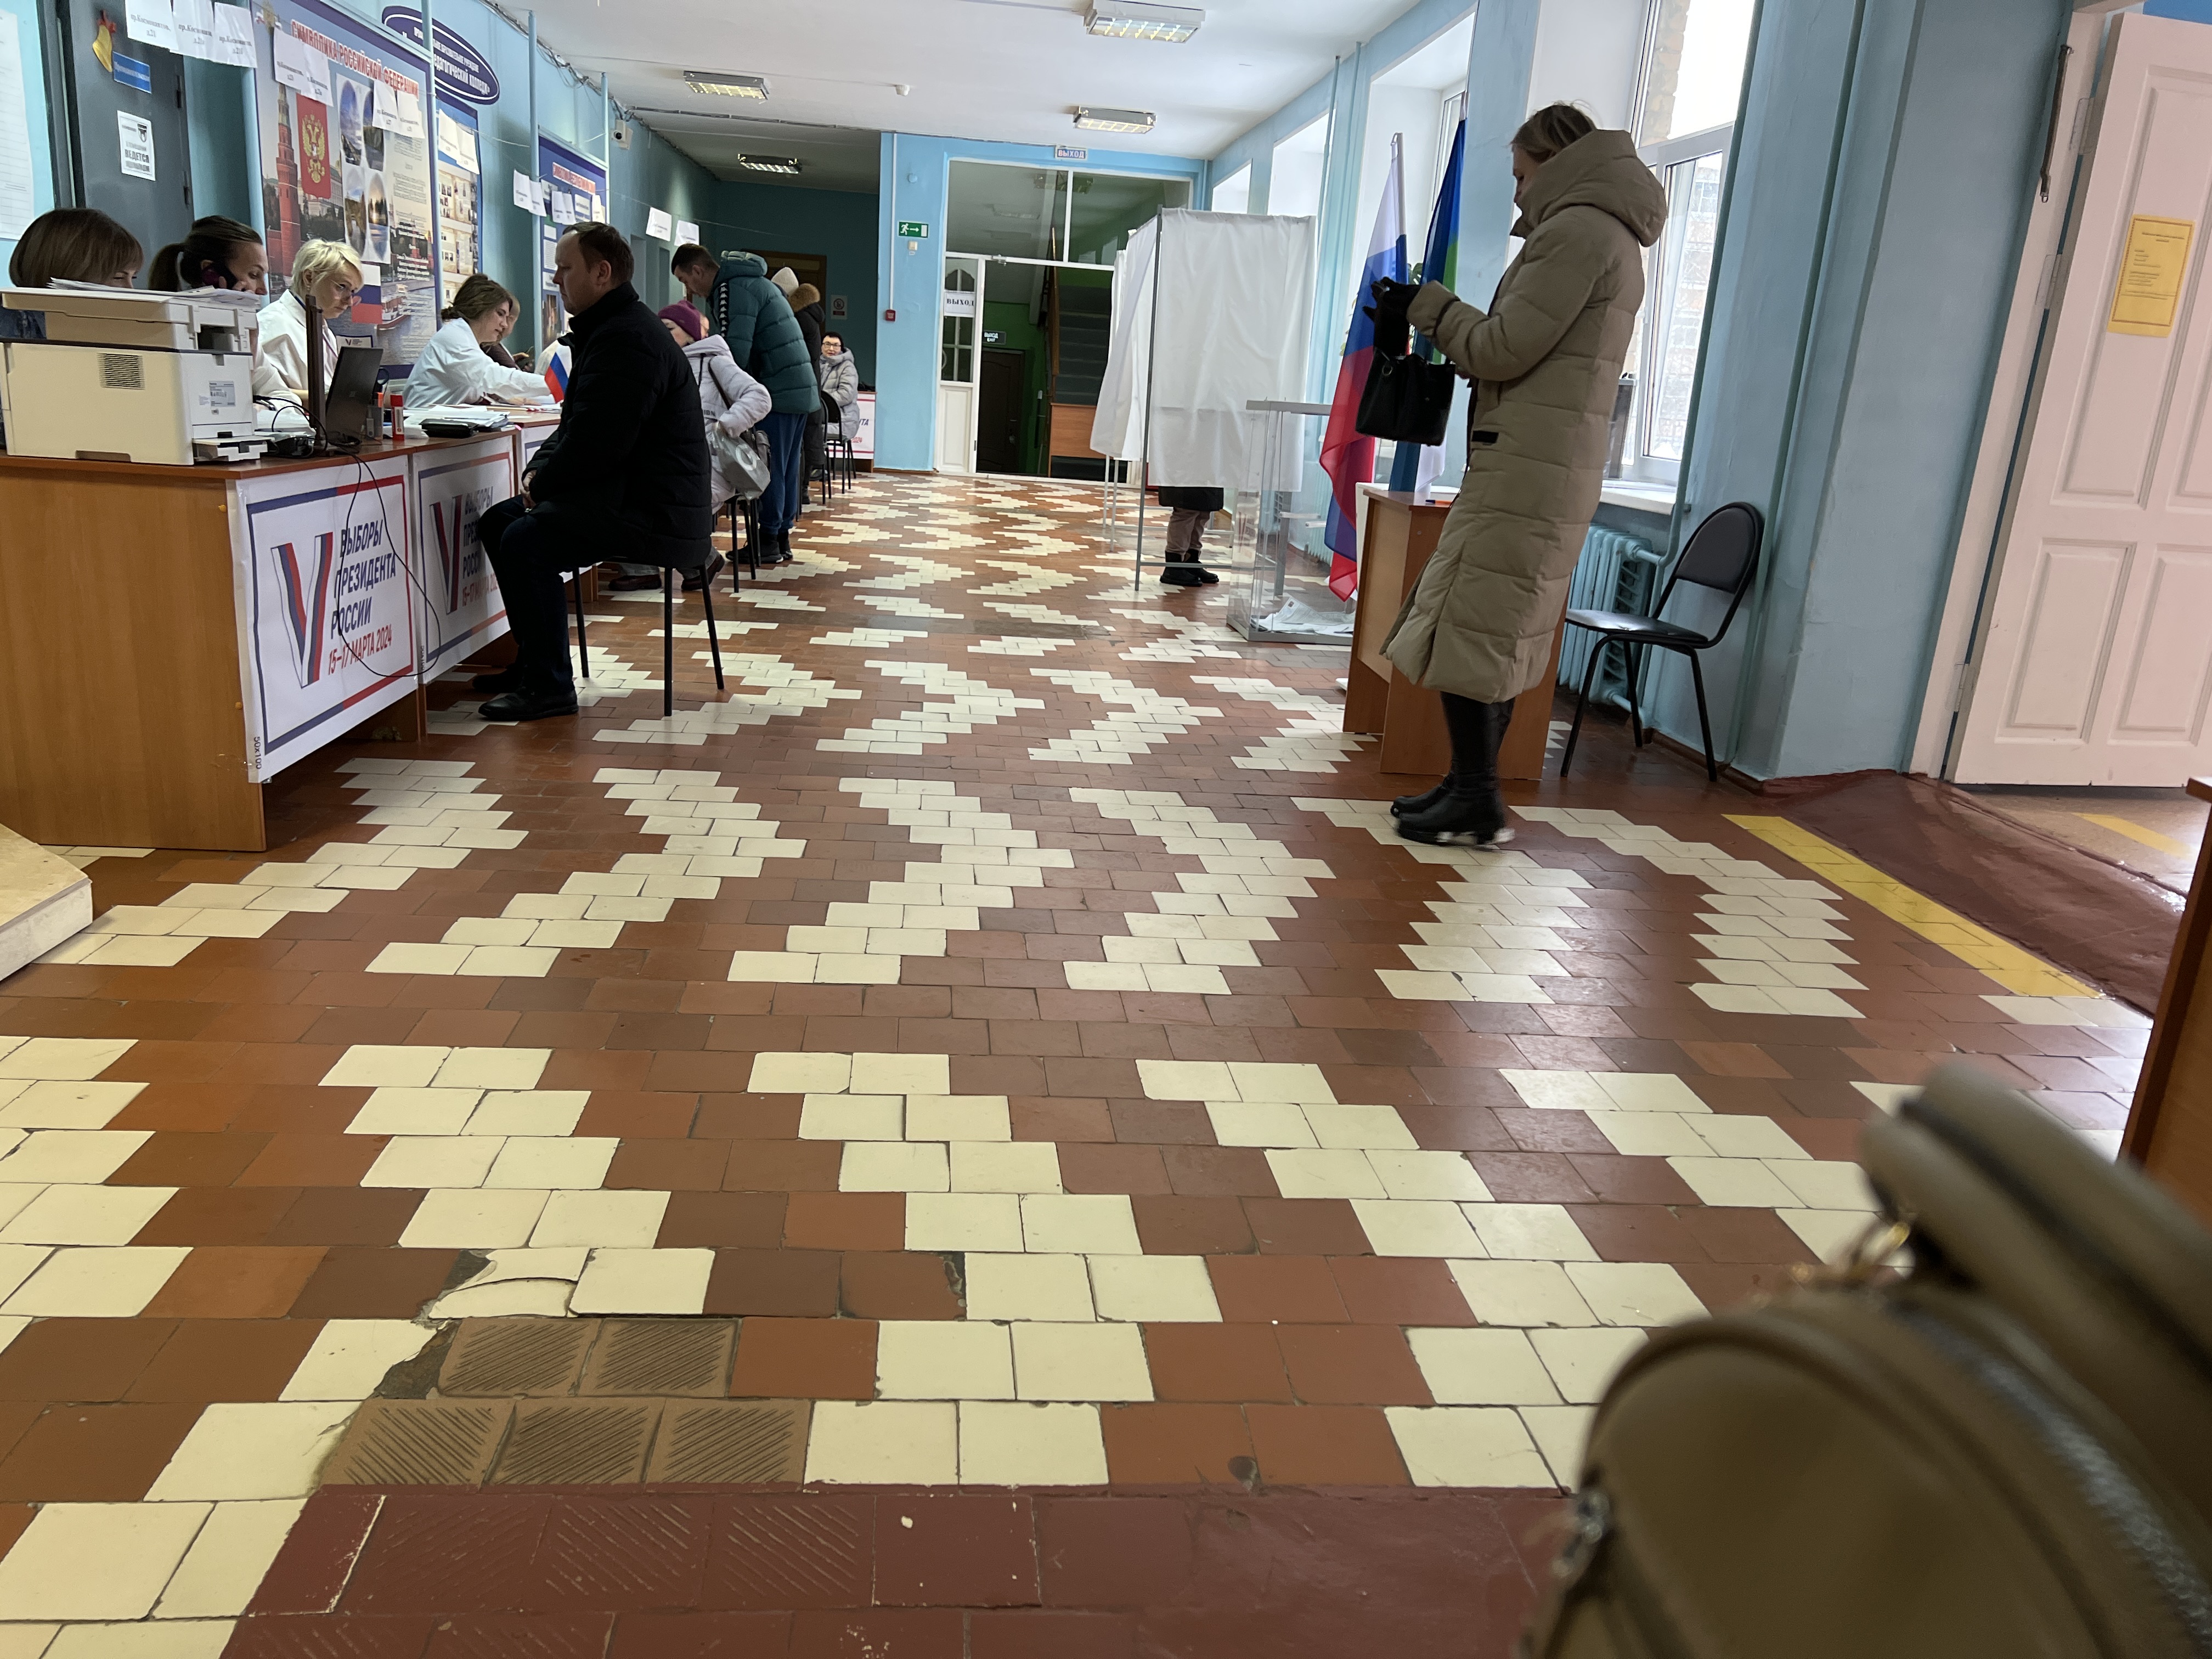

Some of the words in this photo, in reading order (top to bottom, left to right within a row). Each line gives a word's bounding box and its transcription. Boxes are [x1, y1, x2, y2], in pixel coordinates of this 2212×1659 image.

[338, 48, 382, 81] РОССИЙСКОЙ
[1058, 150, 1085, 159] ВЫХОД
[947, 298, 974, 307] ВЫХОД
[340, 519, 383, 557] ВЫБОРЫ
[334, 552, 396, 598] ПРЕЗИДЕНТА
[331, 596, 372, 639] РОССИИ
[350, 631, 375, 665] МАРТА
[376, 624, 393, 652] 2024
